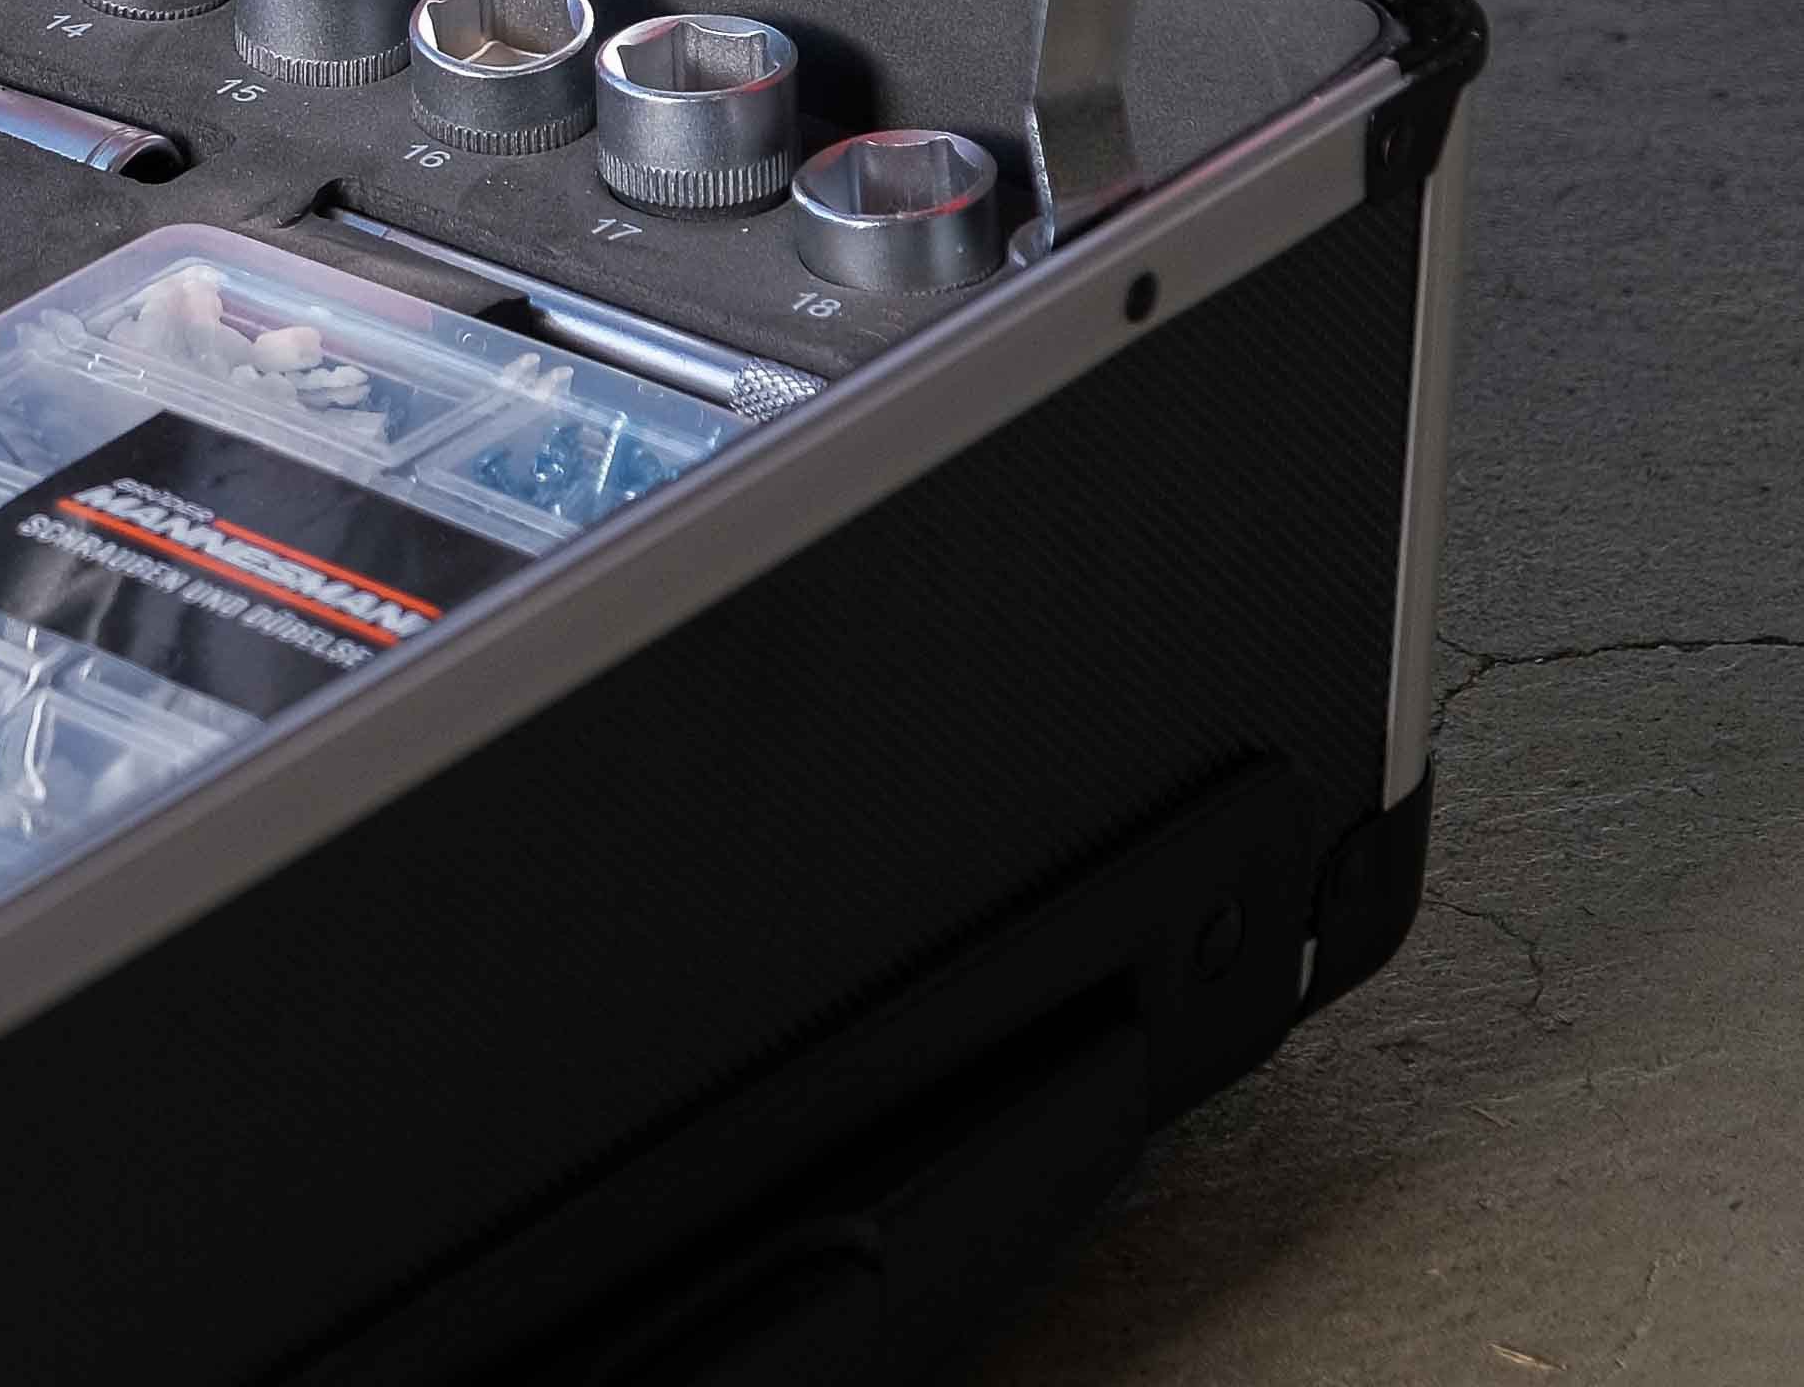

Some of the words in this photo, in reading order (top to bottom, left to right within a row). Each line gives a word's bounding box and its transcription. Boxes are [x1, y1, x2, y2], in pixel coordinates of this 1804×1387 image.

[46, 13, 94, 40] 14
[215, 78, 268, 104] 15
[401, 141, 451, 170] 16
[590, 216, 644, 243] 17
[791, 289, 840, 319] 18
[71, 484, 433, 638] MANNESMAN
[182, 577, 250, 619] UND
